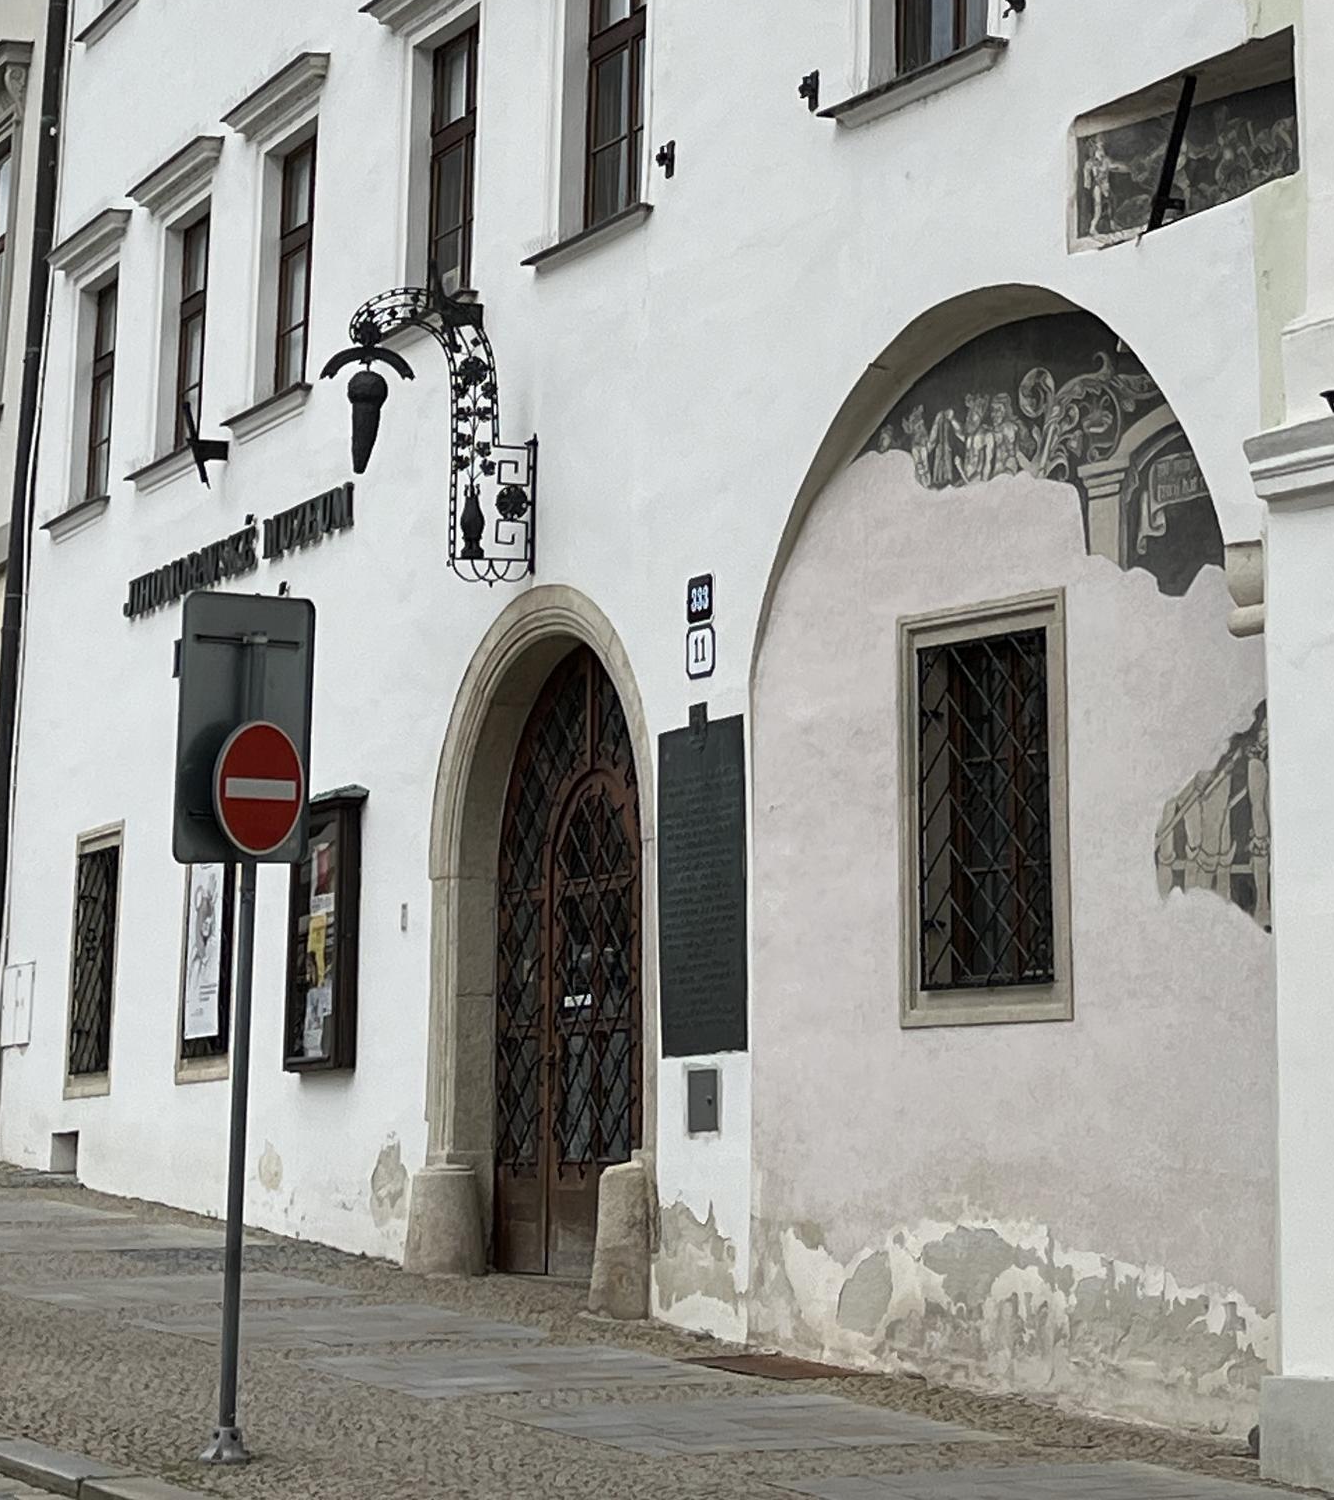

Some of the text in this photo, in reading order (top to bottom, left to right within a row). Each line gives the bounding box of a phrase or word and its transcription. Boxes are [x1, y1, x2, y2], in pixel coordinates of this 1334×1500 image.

[262, 481, 355, 561] MUZEUM
[690, 584, 710, 613] 333
[694, 635, 706, 663] 11
